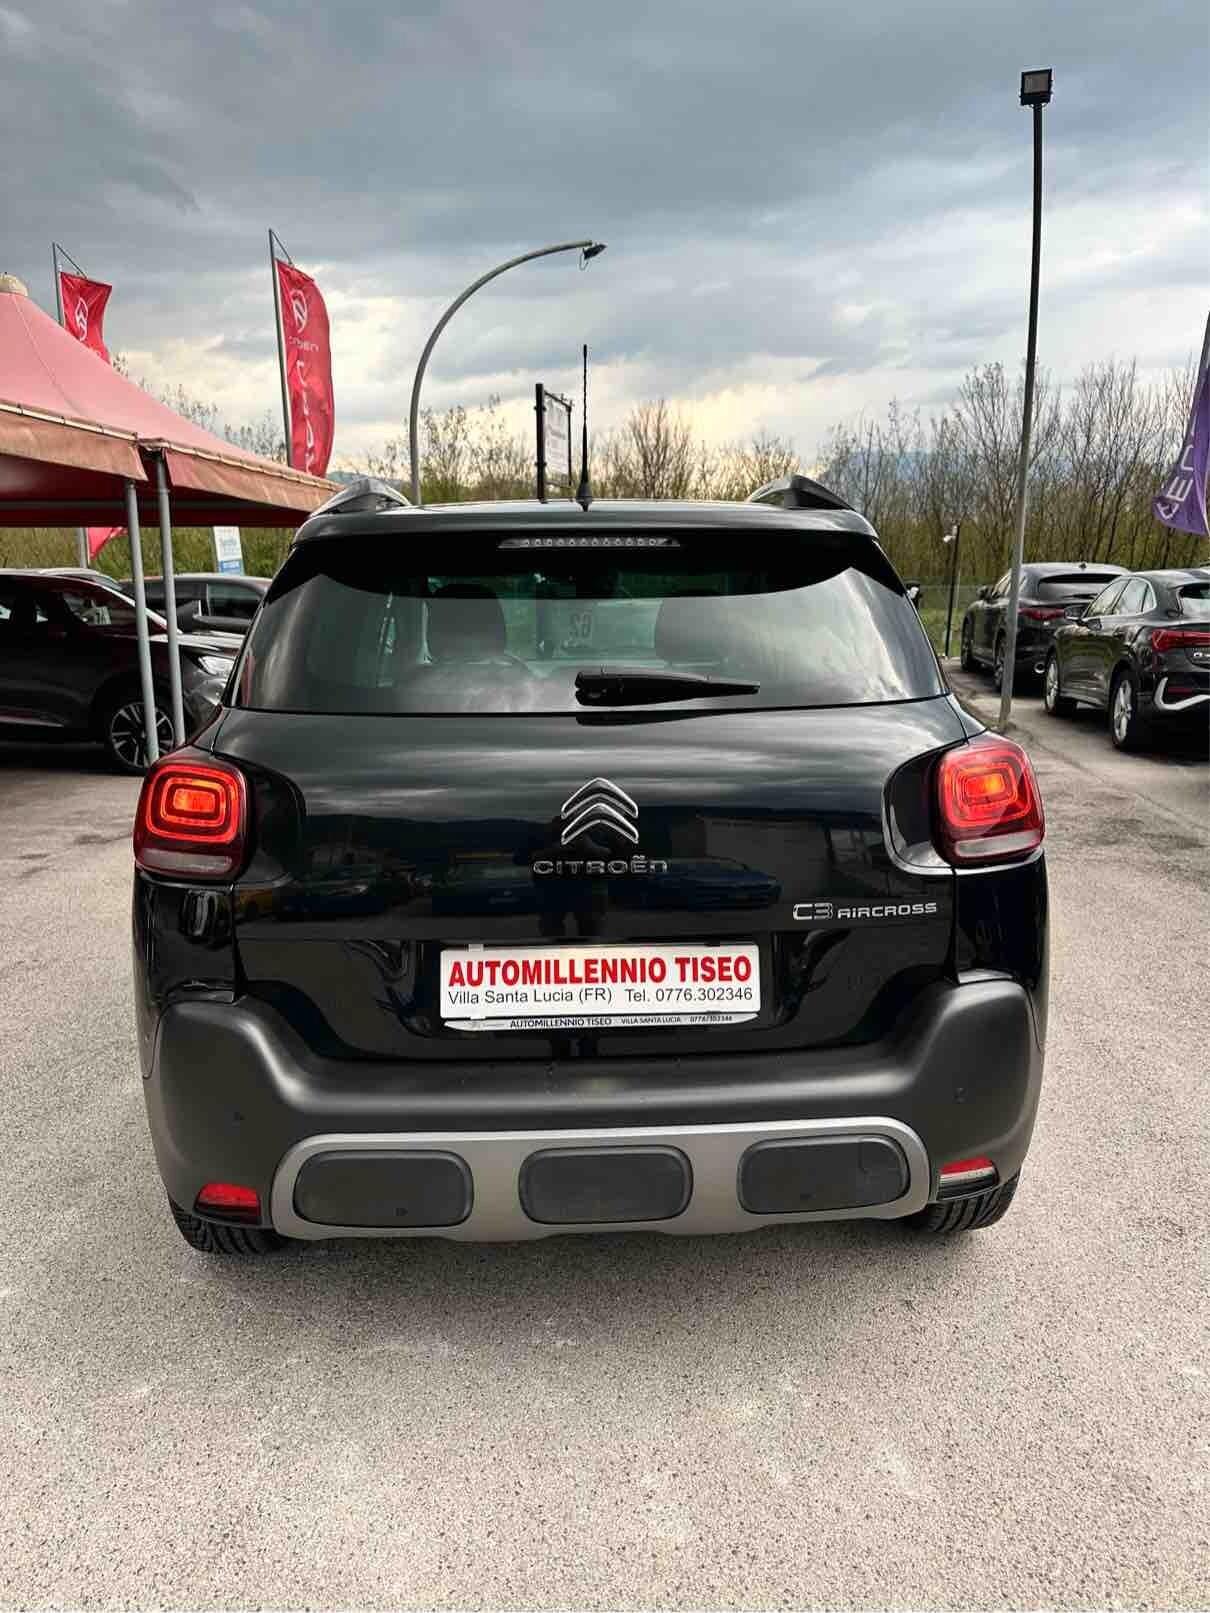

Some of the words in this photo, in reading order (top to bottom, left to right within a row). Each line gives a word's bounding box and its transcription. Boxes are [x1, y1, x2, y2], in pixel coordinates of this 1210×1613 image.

[793, 902, 833, 920] C3
[837, 902, 937, 919] AIRCROSS
[448, 957, 667, 987] AUTOMILLENNIO
[674, 955, 752, 983] TISEO
[448, 989, 479, 1004] Villa
[485, 989, 528, 1004] Santa
[534, 988, 573, 1002] Lucia
[578, 987, 612, 1004] (FR)
[625, 988, 650, 1002] Tel.
[656, 987, 753, 1001] 0776.302346
[510, 1018, 585, 1028] AUTOMILLENNIO
[587, 1017, 612, 1026] TISEO
